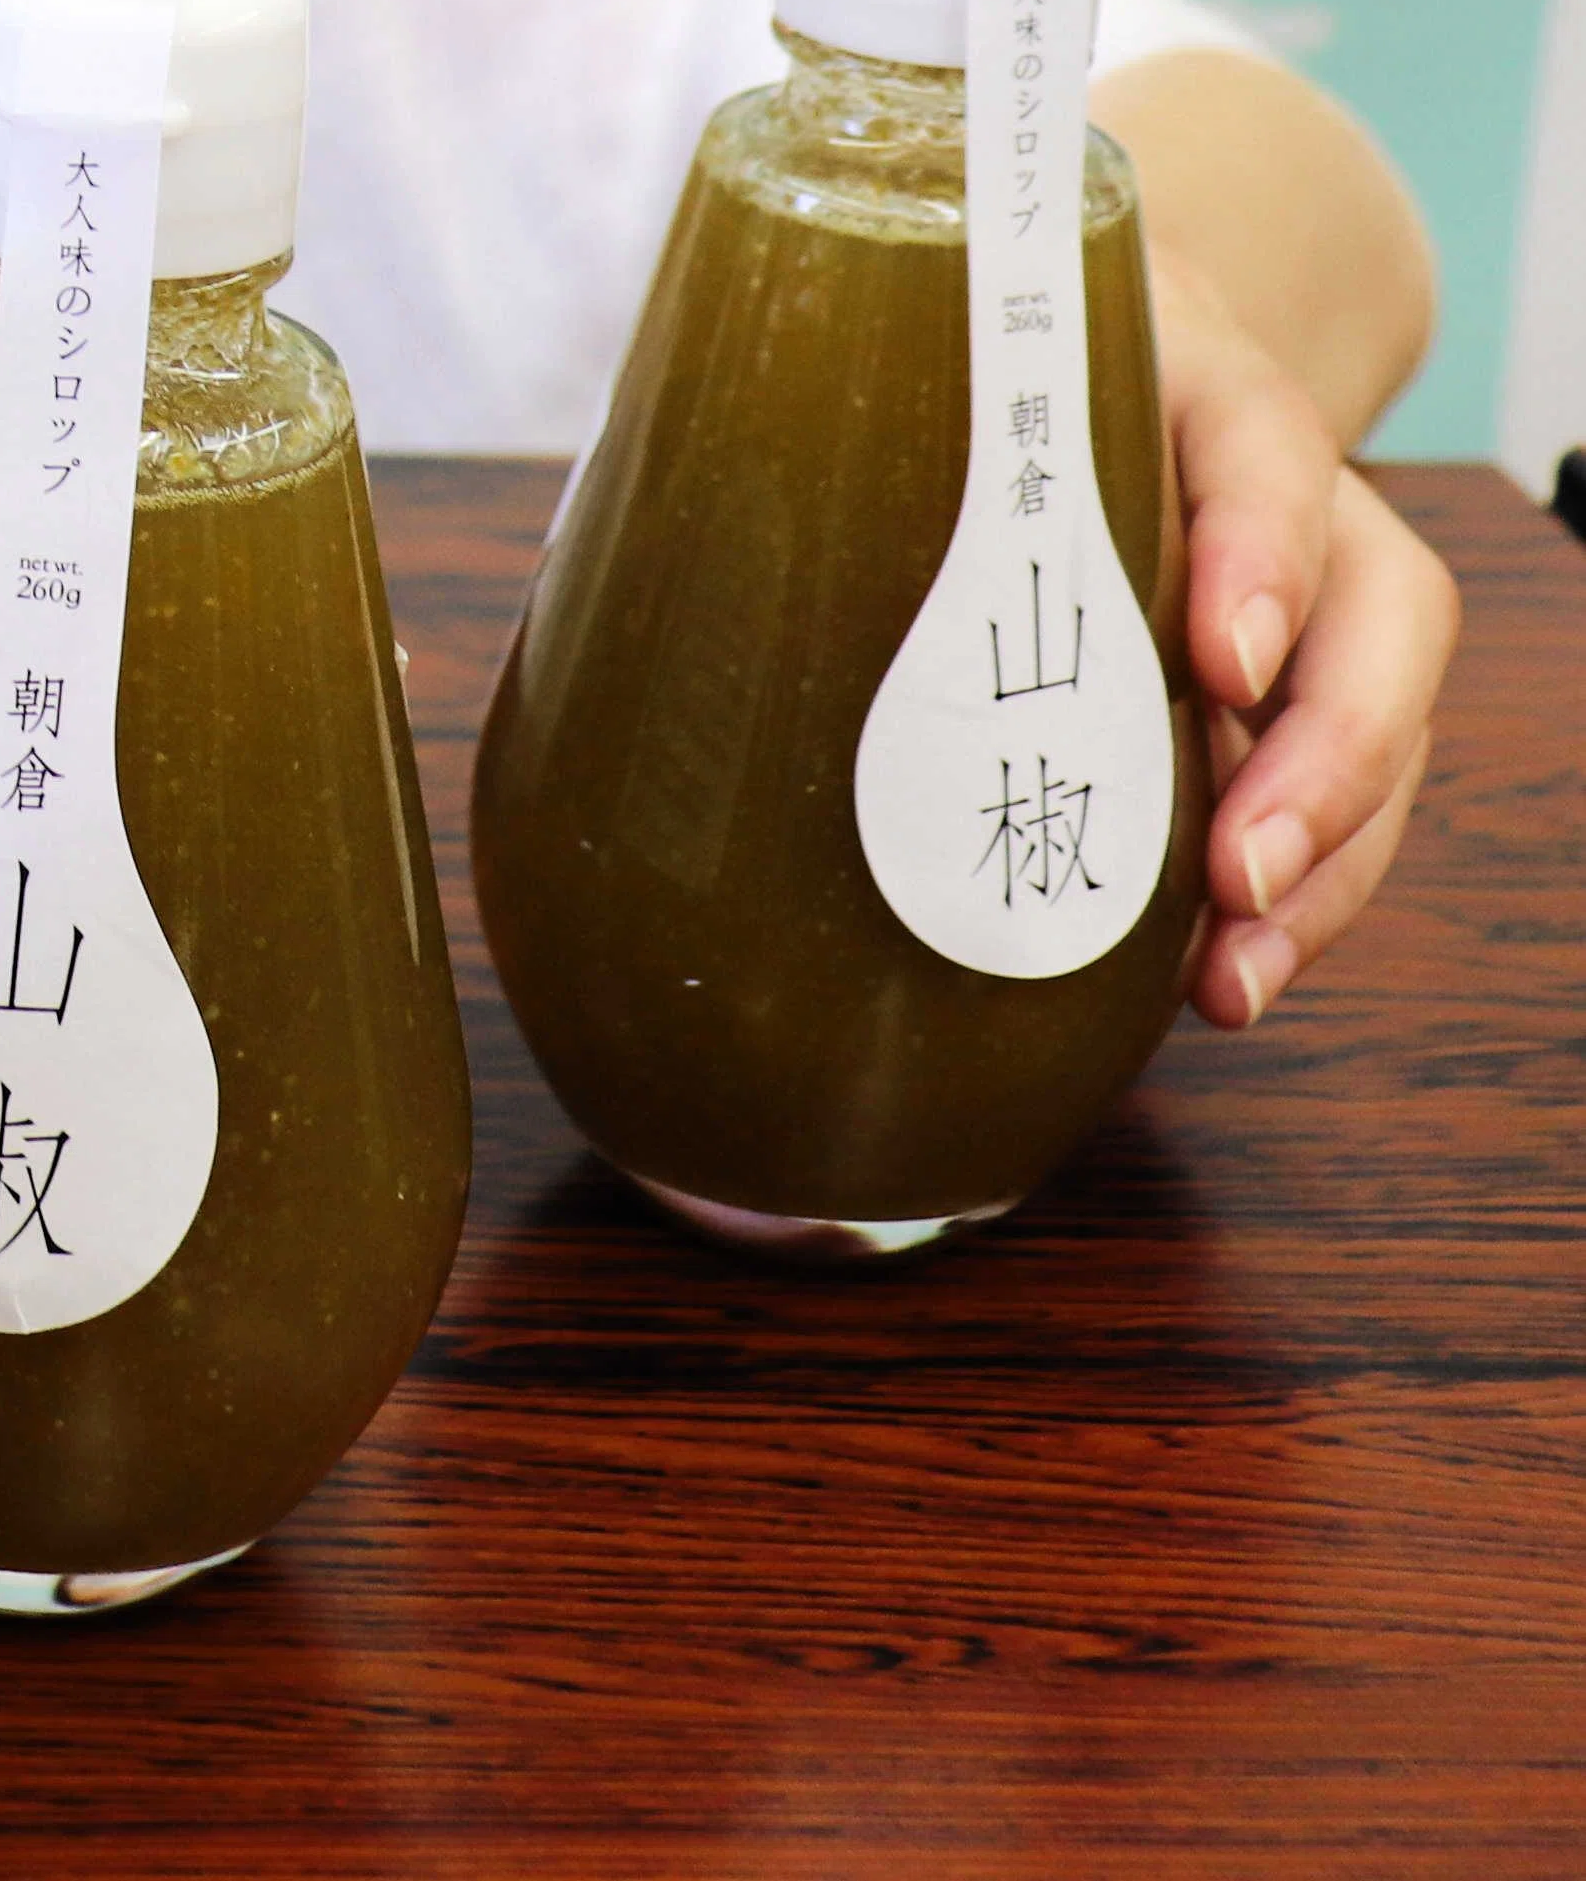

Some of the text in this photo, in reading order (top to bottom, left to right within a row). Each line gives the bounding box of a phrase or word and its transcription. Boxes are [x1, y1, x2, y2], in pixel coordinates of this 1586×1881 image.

[42, 151, 100, 496] 大人味のシロップ
[19, 555, 83, 575] net wt.
[16, 575, 81, 608] 260g
